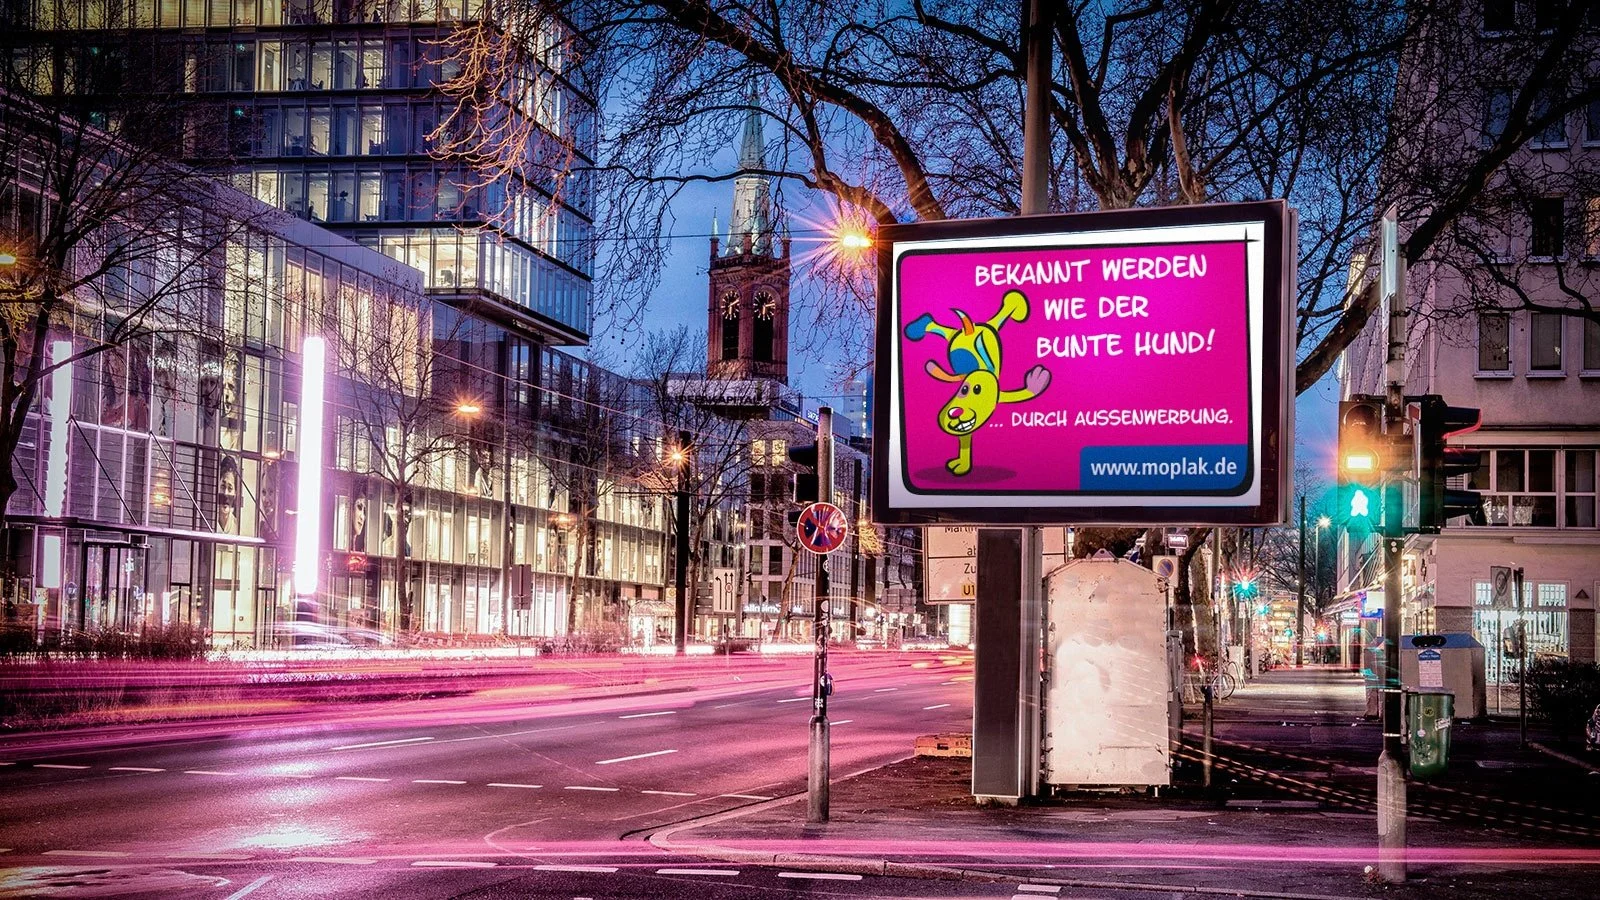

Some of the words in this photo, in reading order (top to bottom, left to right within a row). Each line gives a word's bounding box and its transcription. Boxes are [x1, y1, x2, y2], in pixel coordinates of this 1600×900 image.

[975, 259, 1090, 286] BEKANNT
[1102, 254, 1207, 282] WERDEN
[1044, 297, 1087, 321] WIE
[1098, 296, 1149, 318] DER
[1036, 334, 1123, 358] BUNTE
[1135, 328, 1215, 356] HUND!
[1011, 409, 1067, 427] DURCH
[1074, 408, 1234, 426] AUSSENWERBUNG.
[1090, 456, 1237, 480] www.moplak.de
